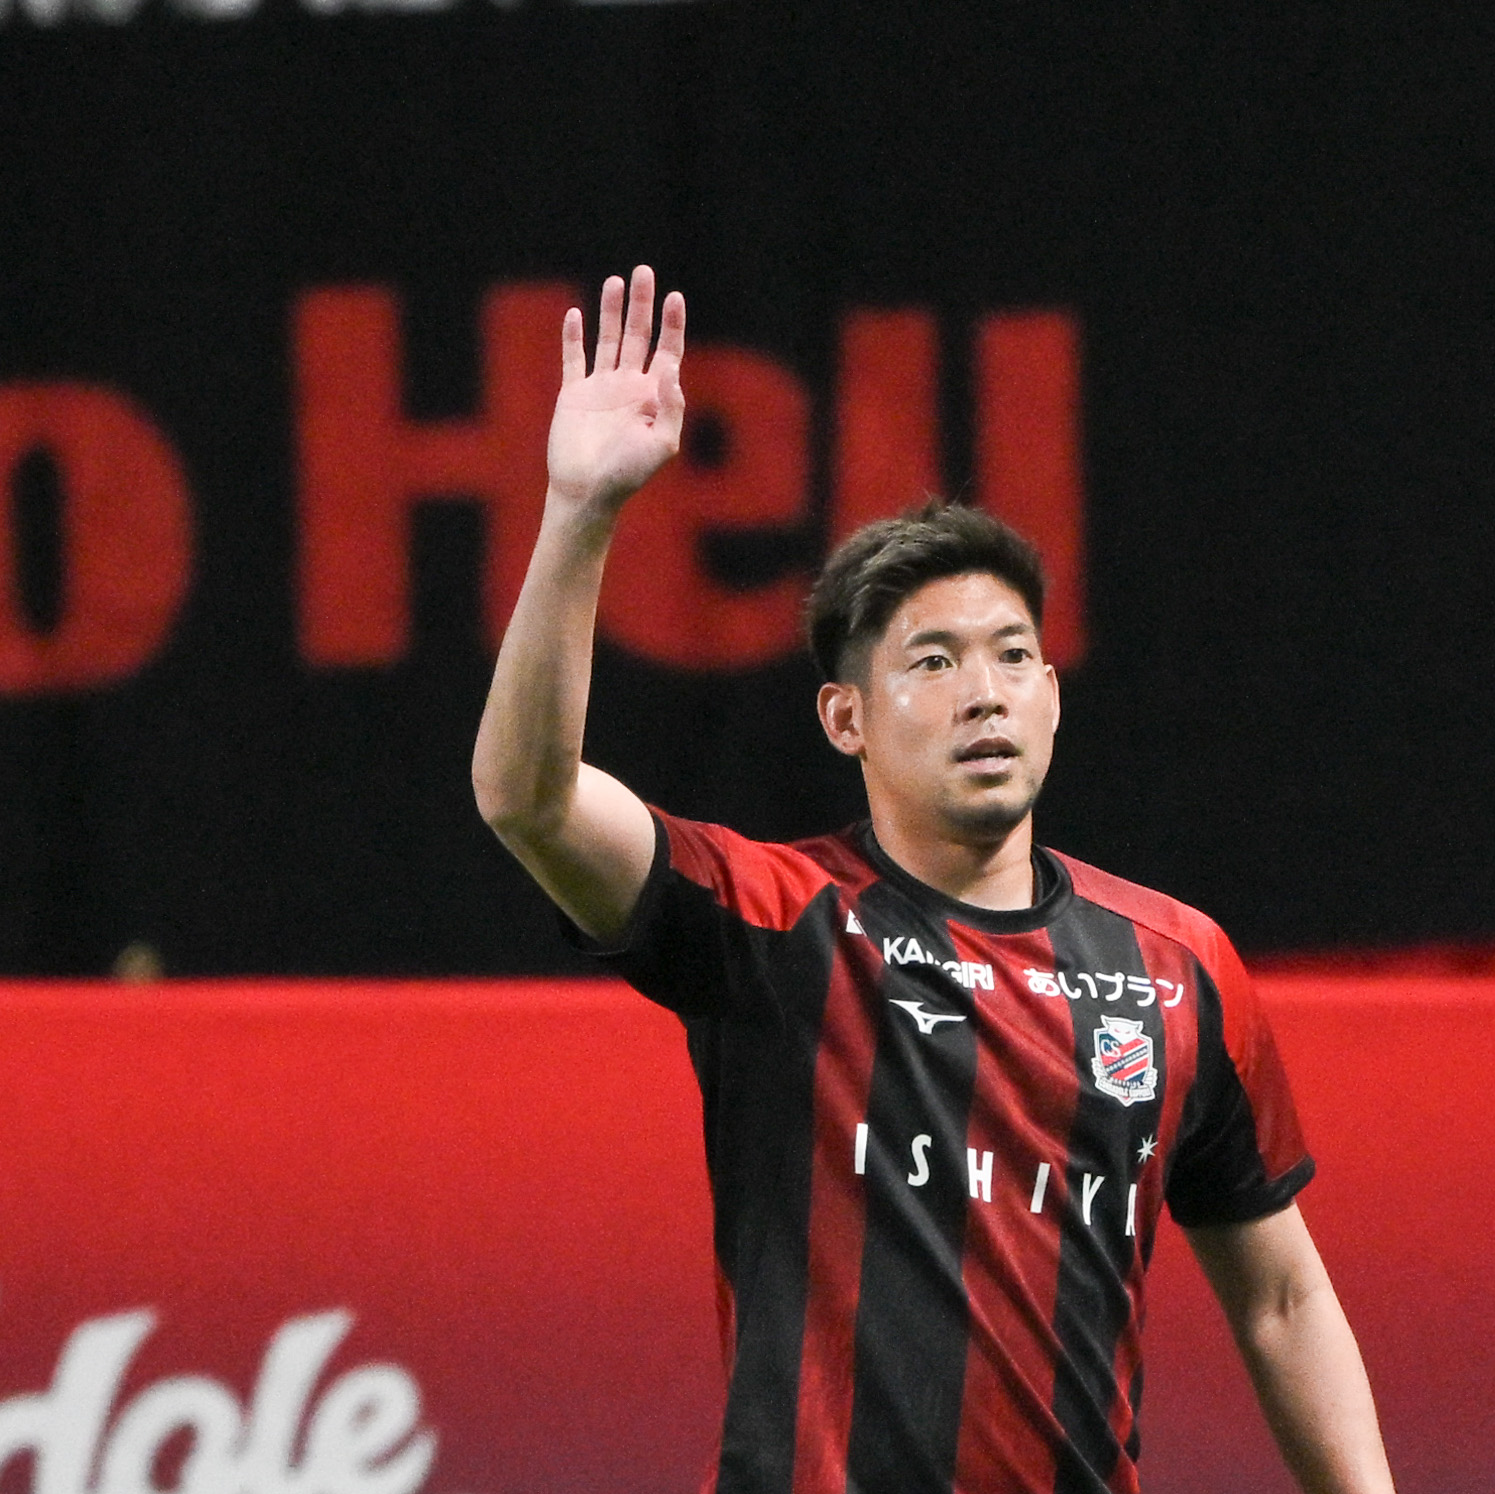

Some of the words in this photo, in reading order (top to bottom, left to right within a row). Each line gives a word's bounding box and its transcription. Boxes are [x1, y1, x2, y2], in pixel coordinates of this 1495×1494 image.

[294, 283, 1088, 672] Hell
[1023, 968, 1184, 1007] あいプラン
